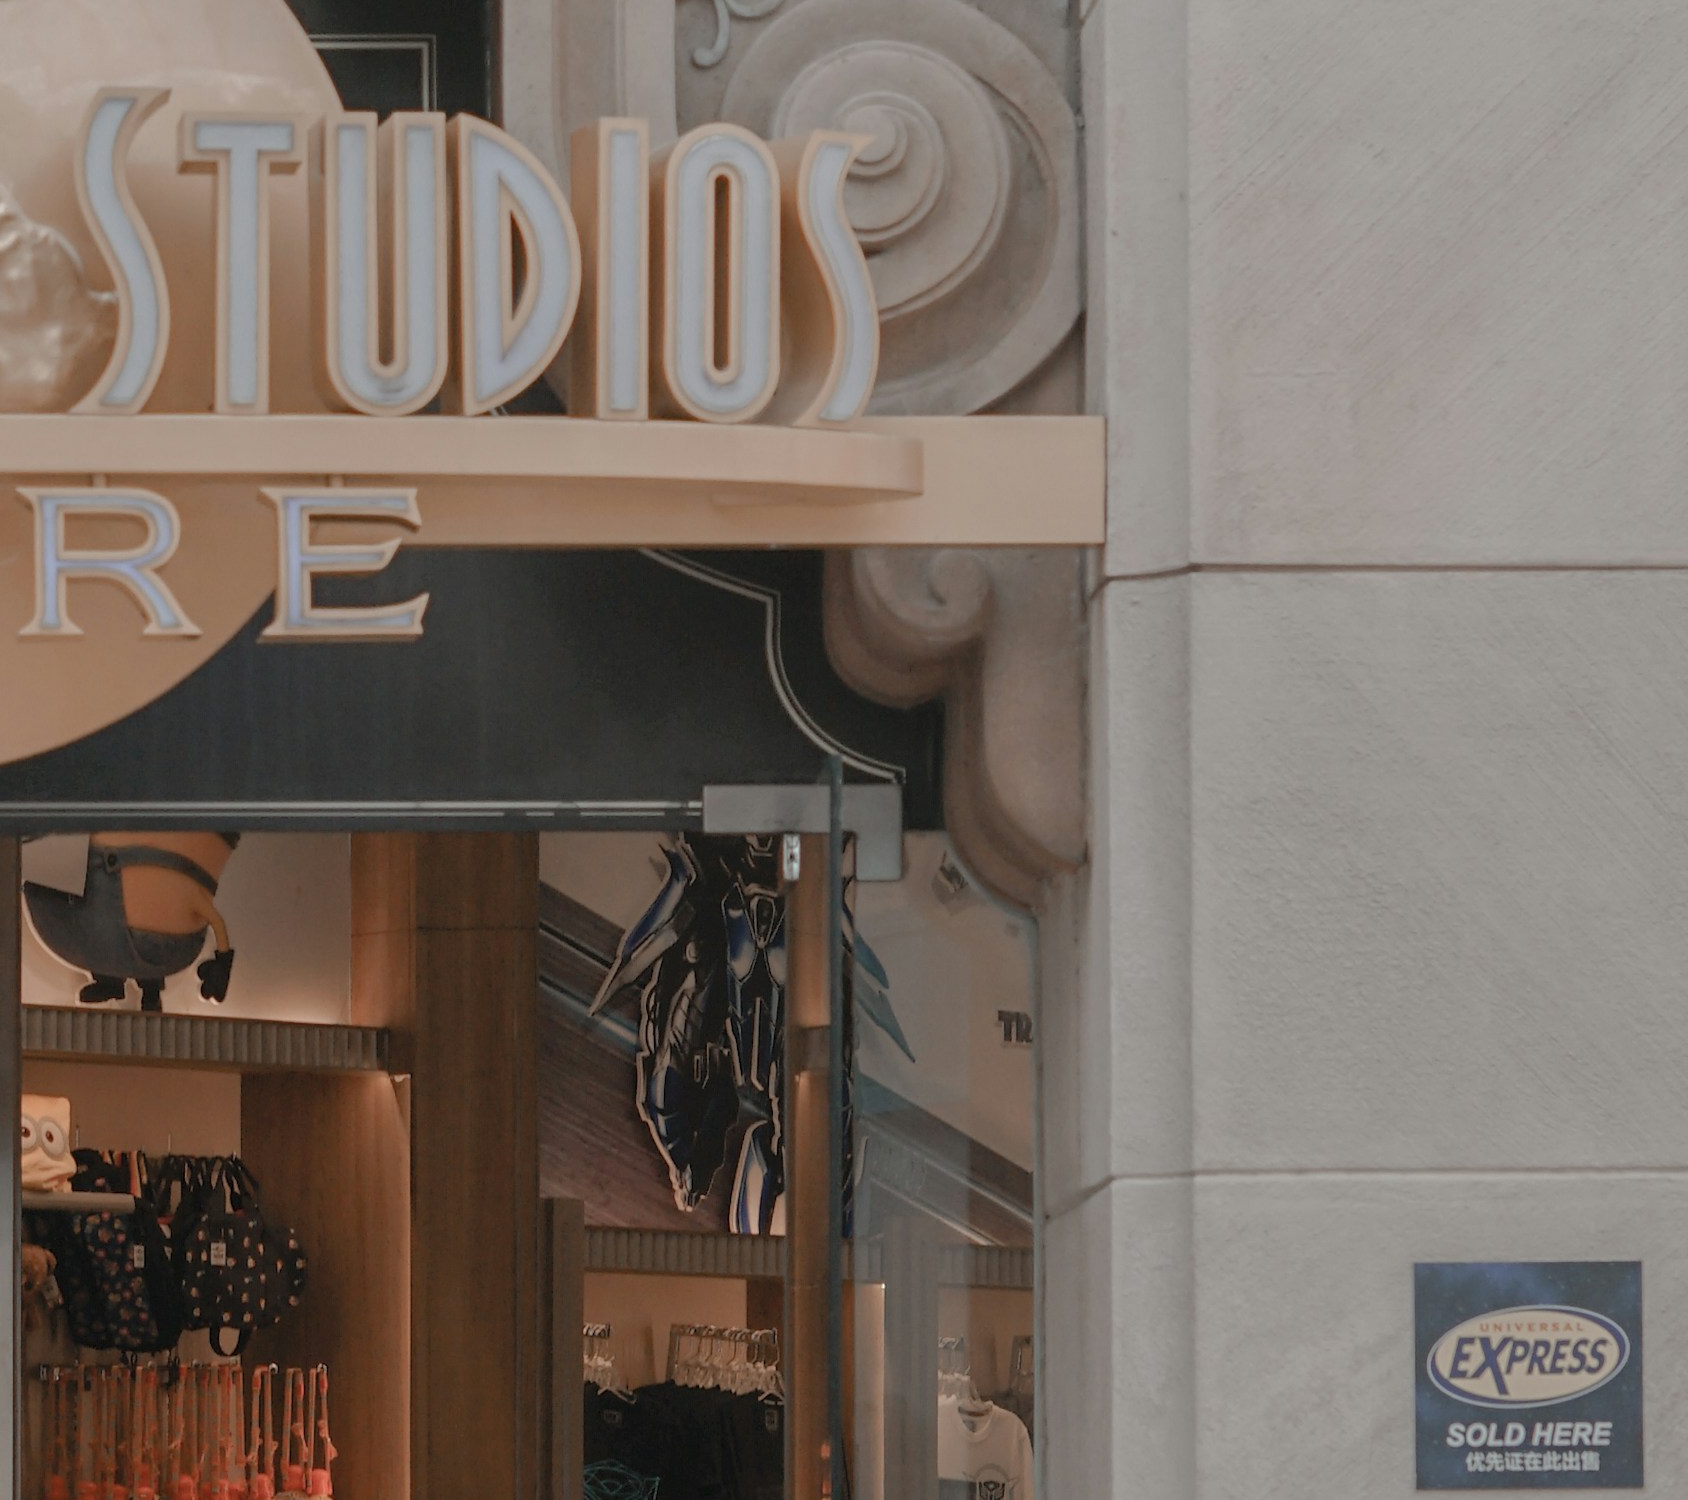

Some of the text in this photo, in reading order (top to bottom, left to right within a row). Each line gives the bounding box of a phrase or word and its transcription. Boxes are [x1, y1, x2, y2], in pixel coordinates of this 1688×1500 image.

[69, 85, 882, 428] STUDIOS
[1479, 1321, 1585, 1333] UNIVERSAL
[1448, 1336, 1610, 1396] EXPRESS
[1446, 1421, 1613, 1448] SOLD HERE
[1465, 1450, 1601, 1473] 优先证在此出售
